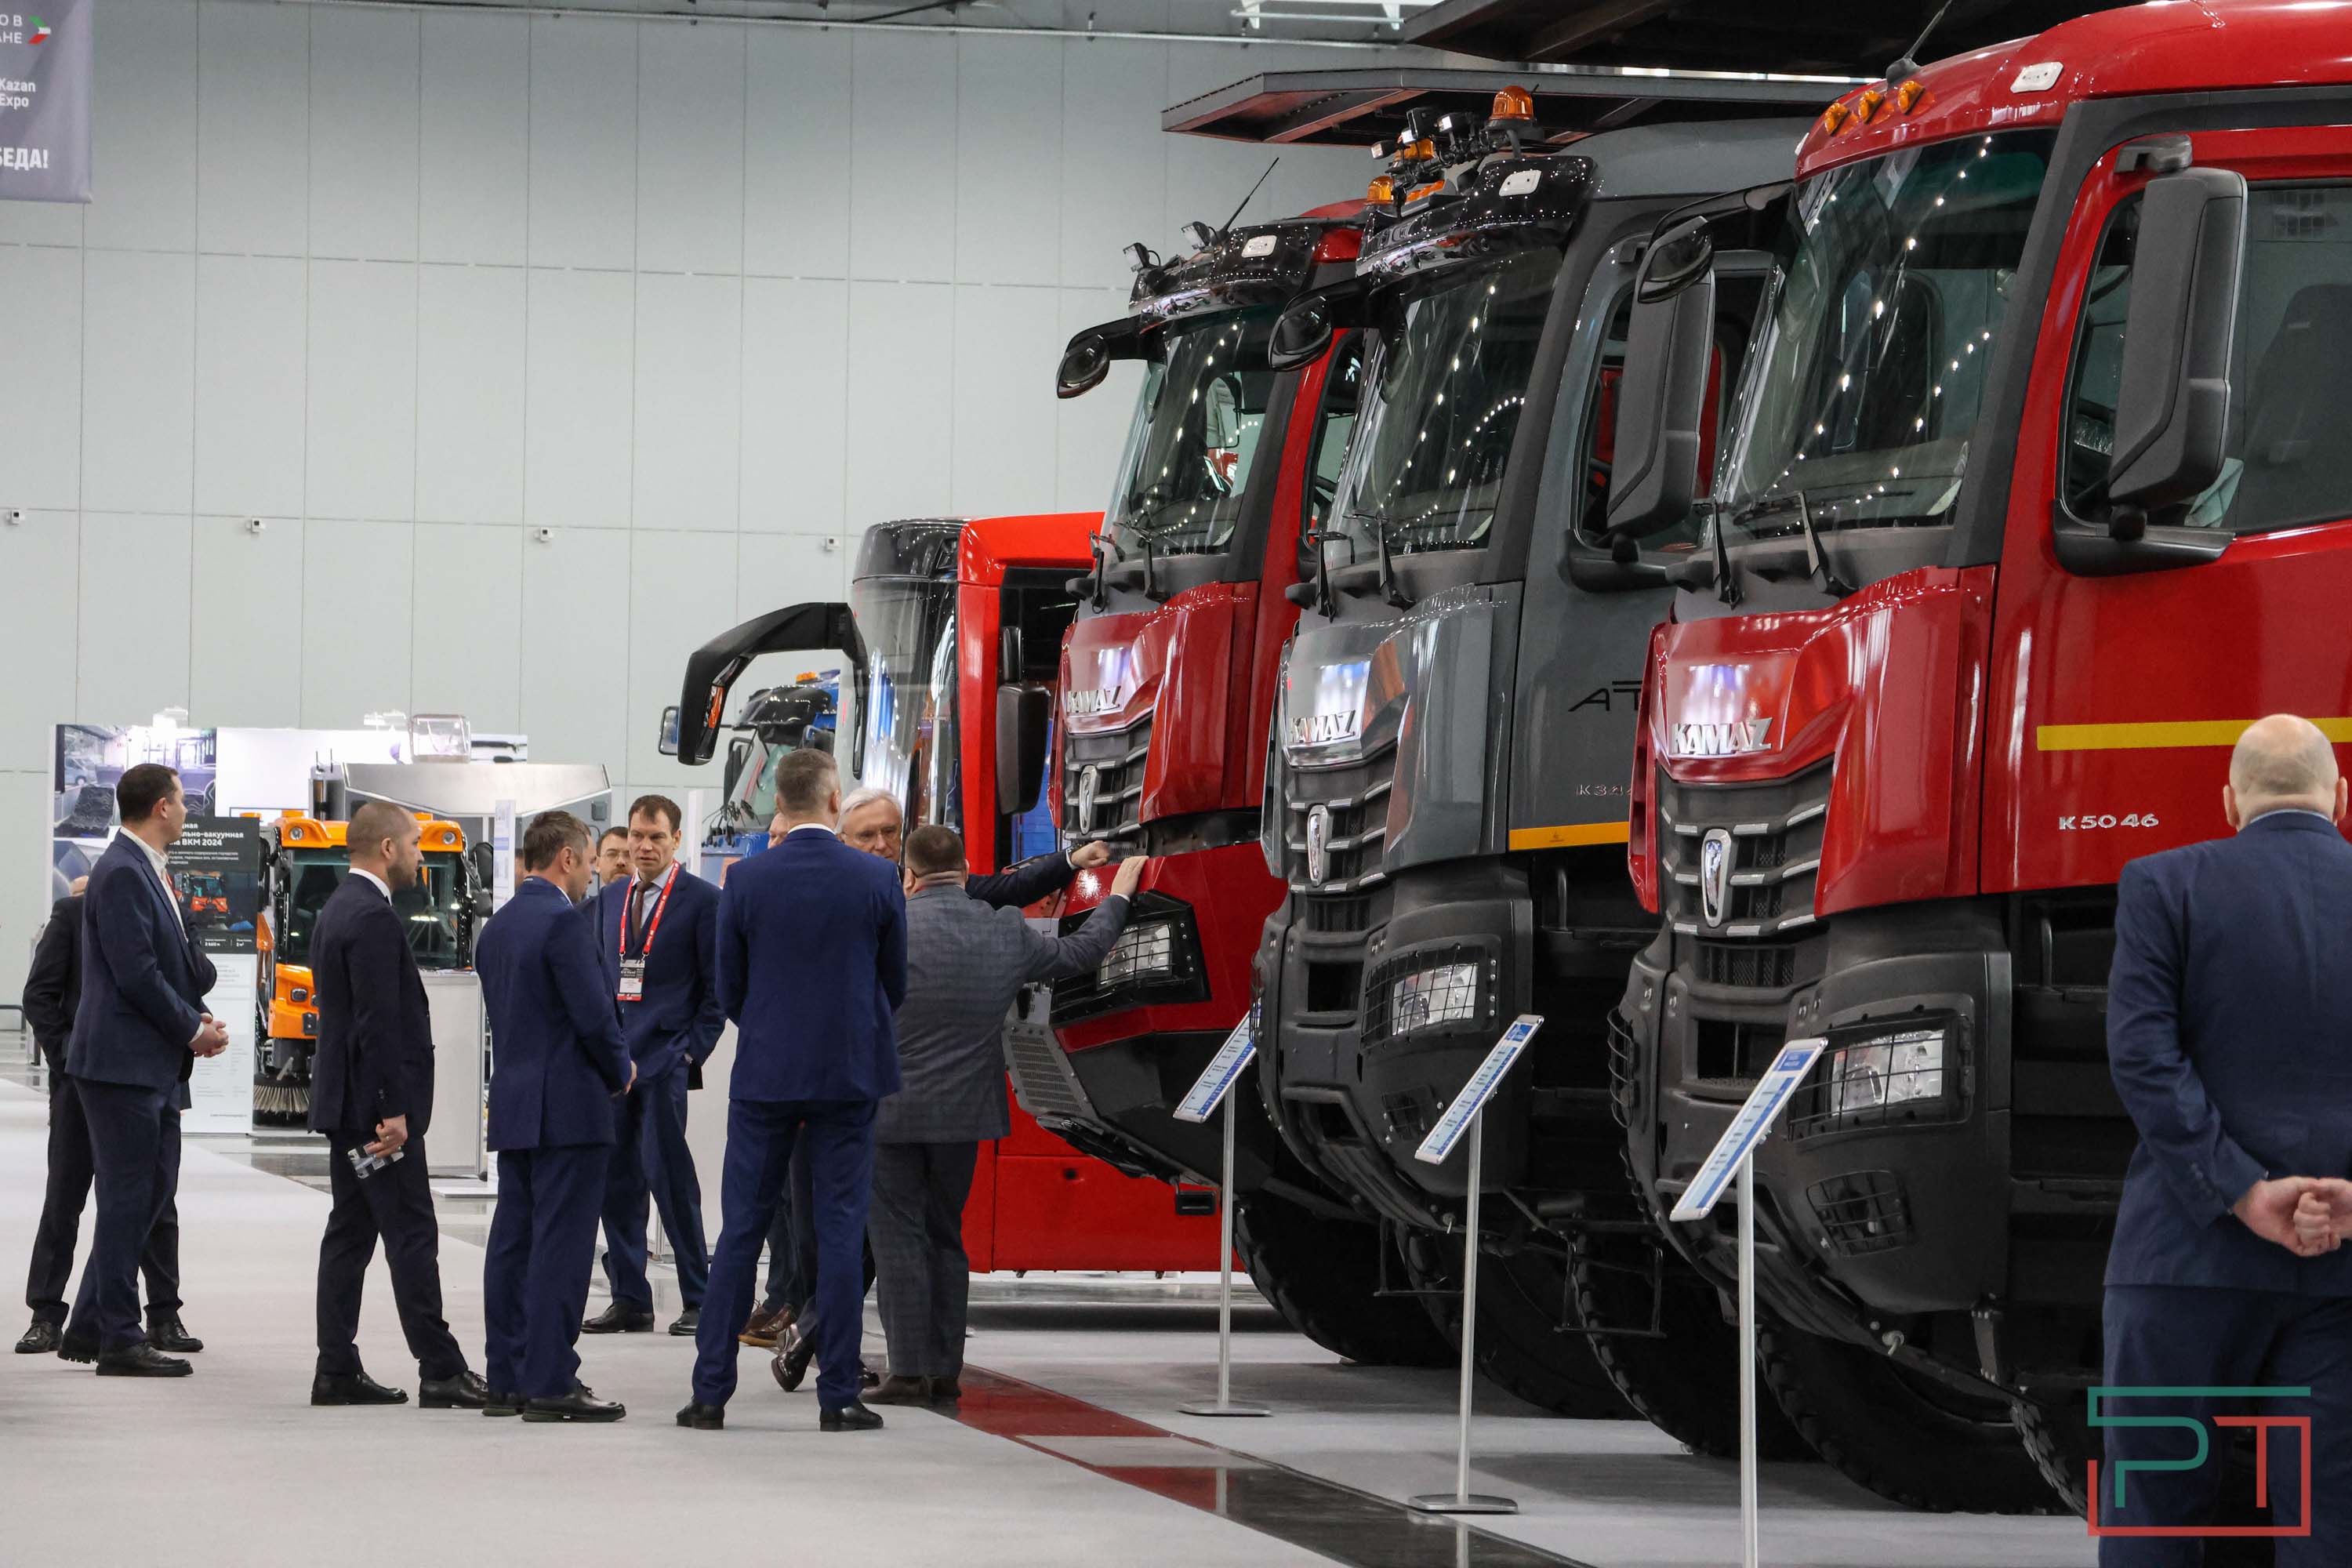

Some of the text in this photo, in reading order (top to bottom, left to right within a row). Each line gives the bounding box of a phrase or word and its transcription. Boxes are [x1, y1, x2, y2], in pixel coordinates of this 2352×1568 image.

[0, 31, 22, 44] НЕ
[0, 78, 35, 92] Kazan
[0, 93, 29, 110] Expo
[0, 147, 49, 171] ЕДА!
[1067, 686, 1121, 713] KAMAZ
[1291, 710, 1356, 743] KAMAZ
[1671, 717, 1773, 755] KAMAZ
